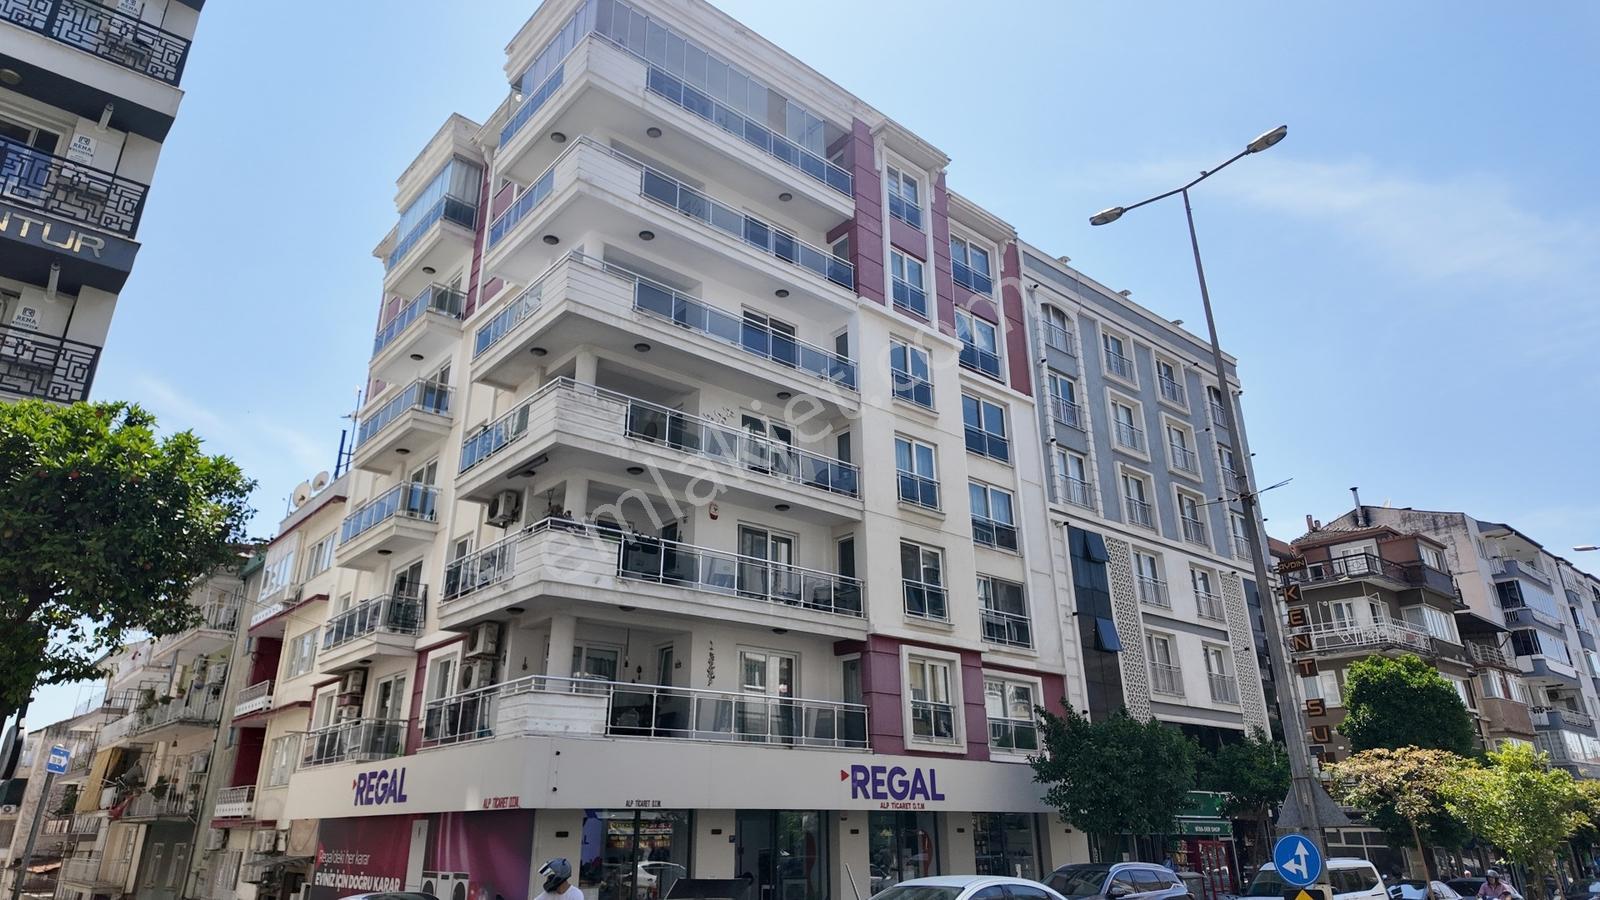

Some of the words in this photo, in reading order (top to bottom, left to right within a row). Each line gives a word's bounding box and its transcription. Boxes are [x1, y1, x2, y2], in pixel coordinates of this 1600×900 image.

[1284, 586, 1313, 675] KENT
[354, 767, 408, 806] REGAL
[851, 764, 945, 801] REGAL
[880, 801, 890, 809] ALP
[355, 849, 371, 865] karar
[373, 877, 401, 892] KARAR
